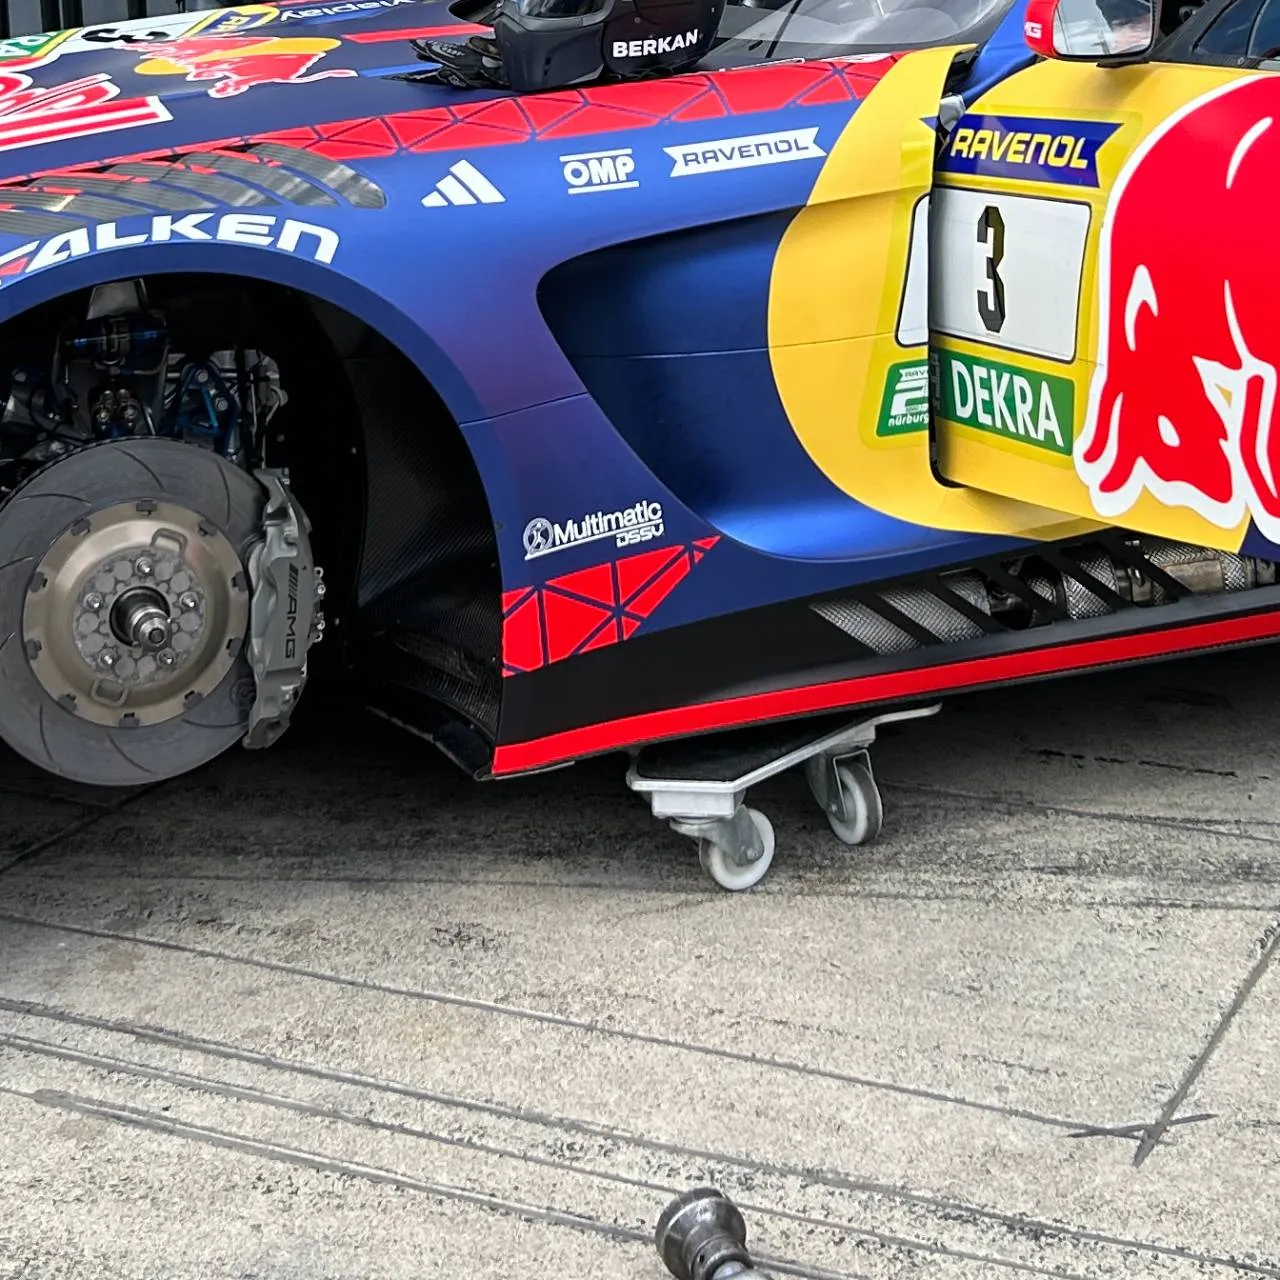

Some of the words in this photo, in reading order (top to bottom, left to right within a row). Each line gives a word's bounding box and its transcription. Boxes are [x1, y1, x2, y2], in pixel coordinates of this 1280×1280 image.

[613, 29, 699, 58] BERKAN
[682, 137, 809, 168] RAVENOL
[950, 128, 1089, 169] RAVENOL
[563, 154, 636, 187] OMP
[976, 205, 1007, 334] 3
[951, 359, 1065, 448] DEKRA
[553, 500, 663, 546] Multimatic
[616, 523, 665, 548] DSSV
[284, 597, 298, 660] AMG
